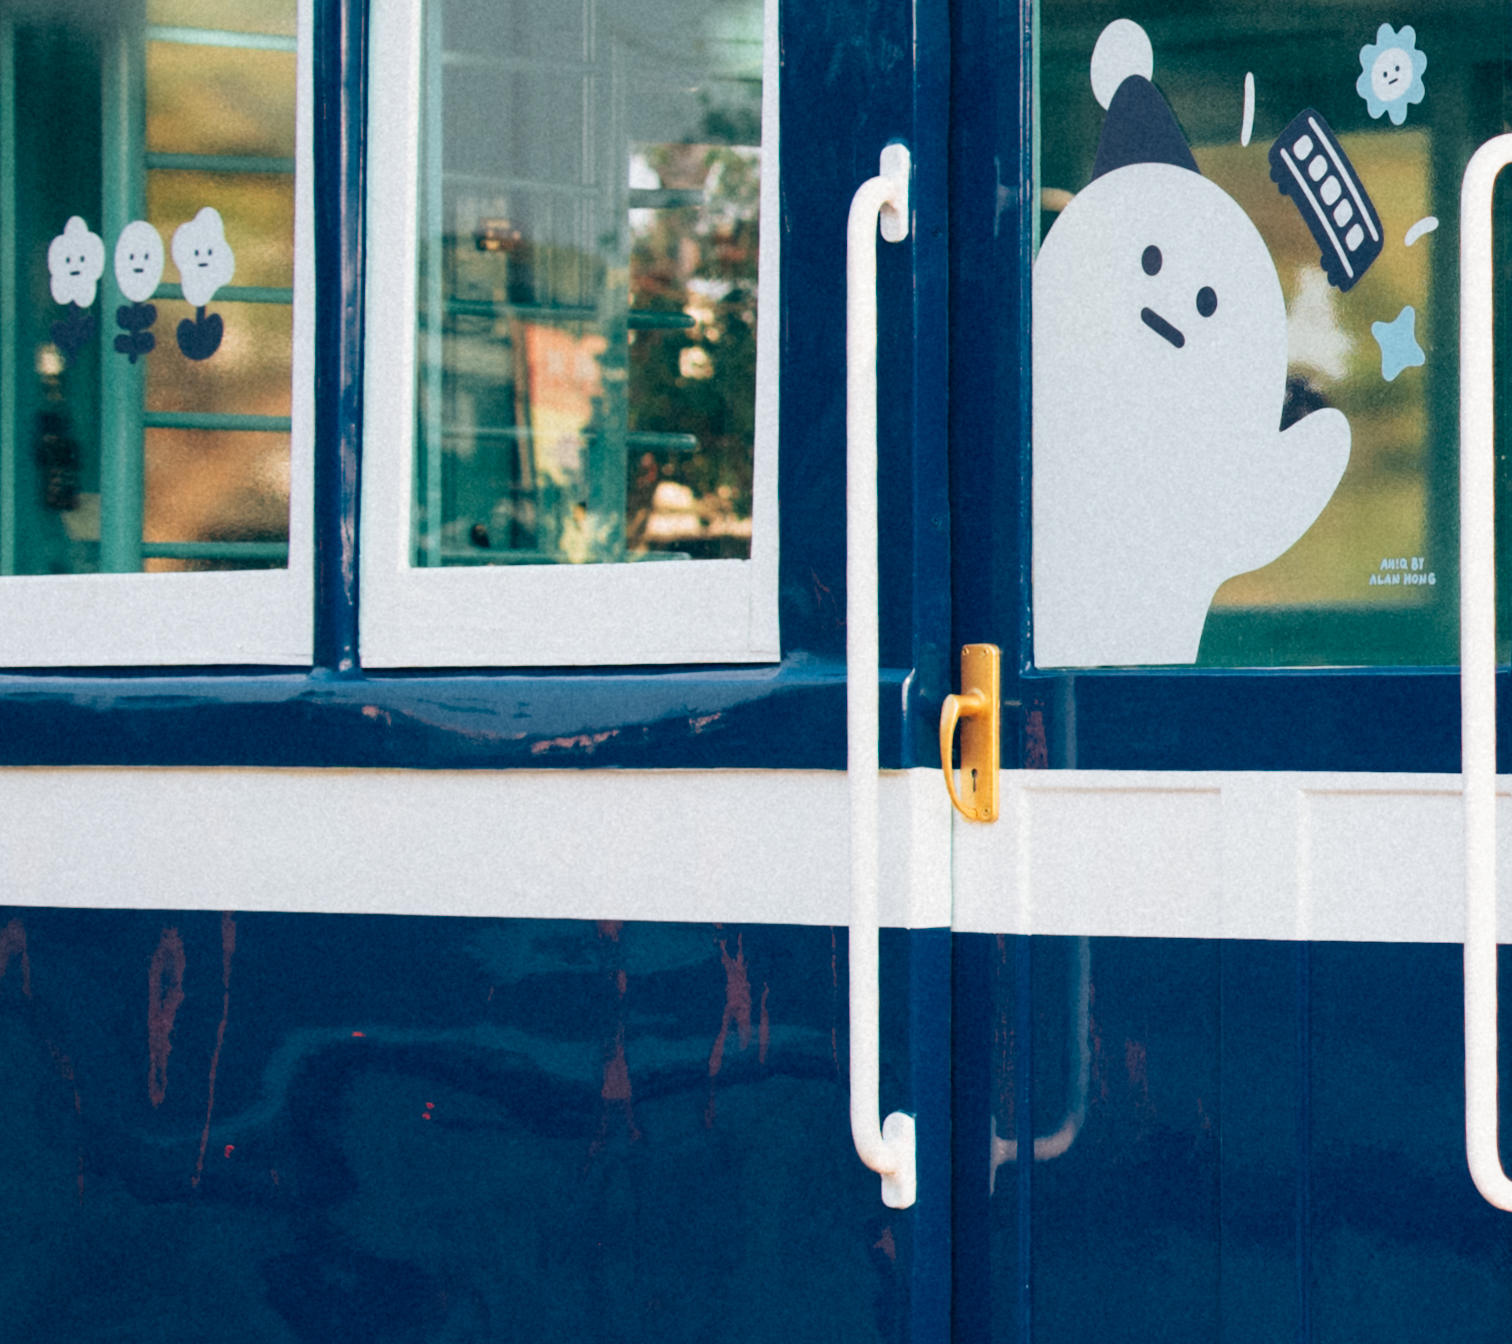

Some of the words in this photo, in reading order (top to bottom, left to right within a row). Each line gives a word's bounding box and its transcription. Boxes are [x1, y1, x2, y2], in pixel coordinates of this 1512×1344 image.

[1411, 557, 1424, 571] BY
[1369, 574, 1400, 586] ALAN
[1403, 572, 1436, 586] HONG
